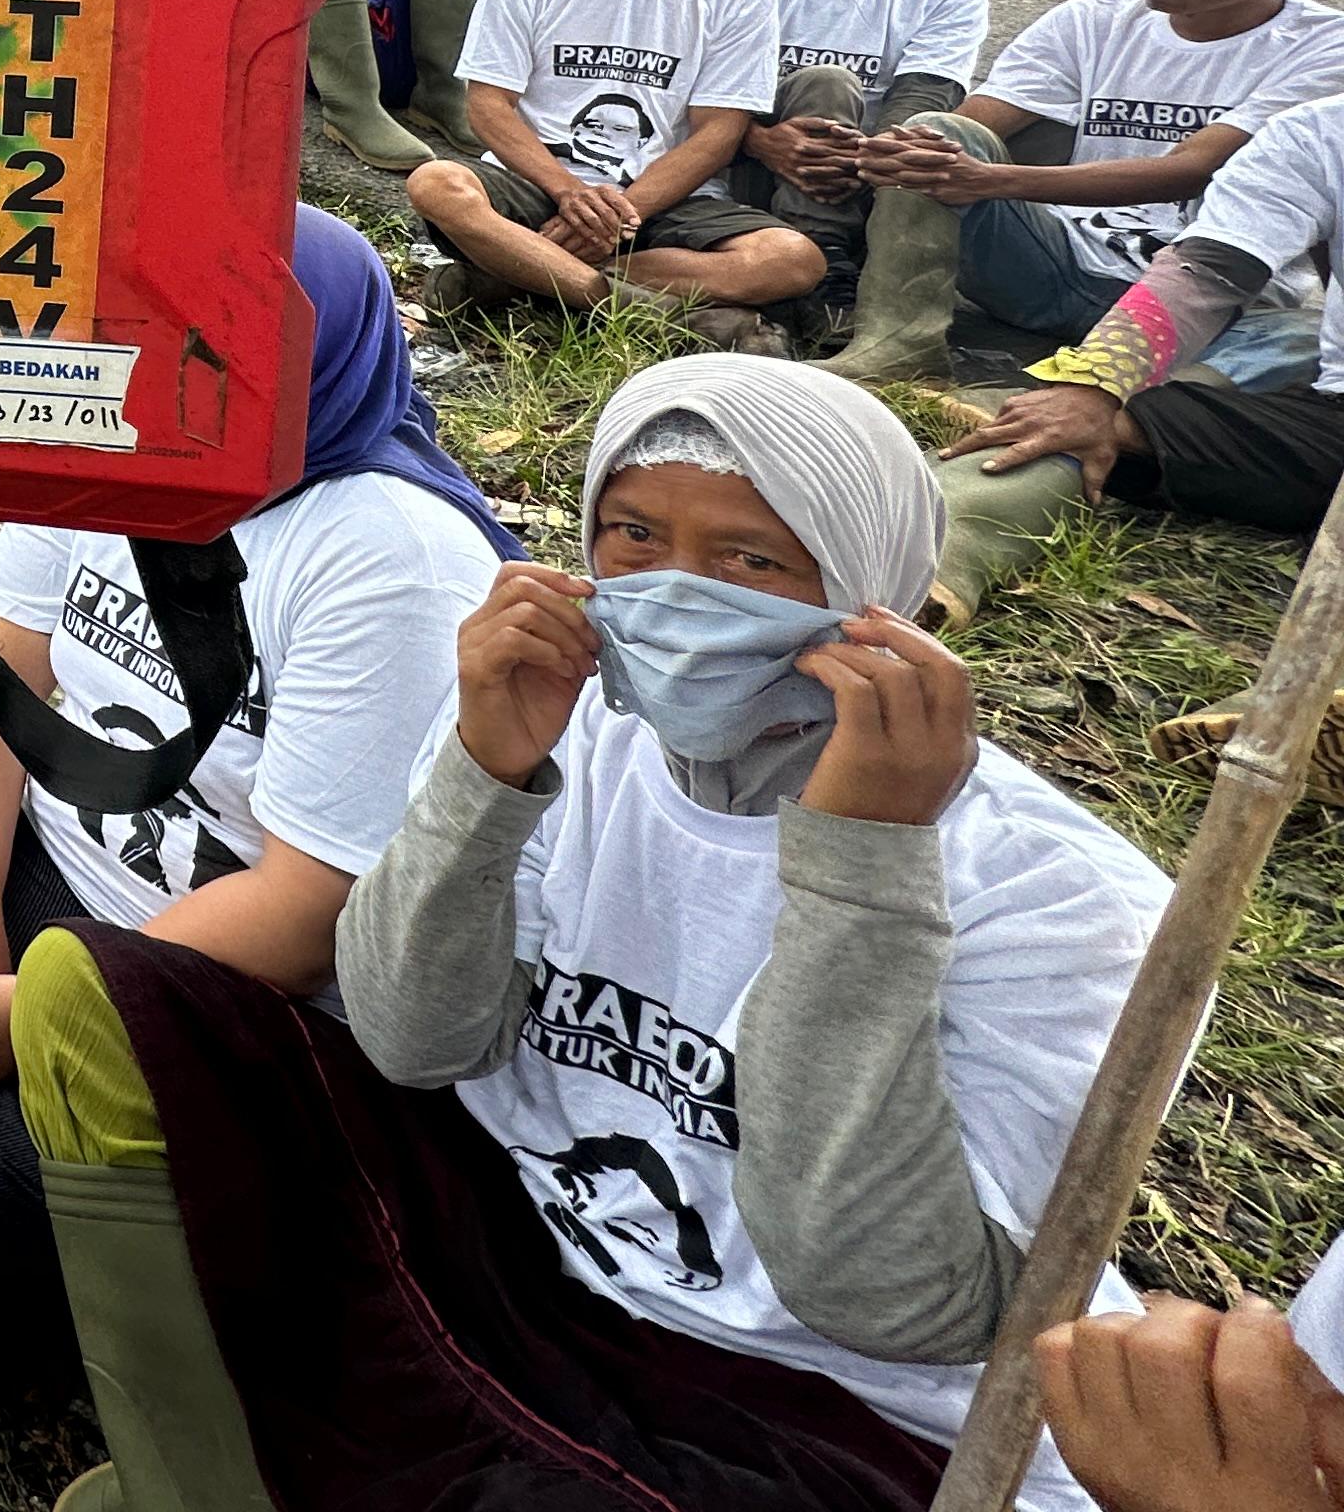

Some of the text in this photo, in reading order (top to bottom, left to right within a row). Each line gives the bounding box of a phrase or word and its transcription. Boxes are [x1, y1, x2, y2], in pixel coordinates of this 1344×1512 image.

[558, 46, 673, 74] PRABOWO
[1089, 123, 1146, 139] UNTUK
[0, 360, 101, 382] BEDAKAH
[64, 608, 133, 665] UNTUK
[522, 1013, 620, 1079] NTUK
